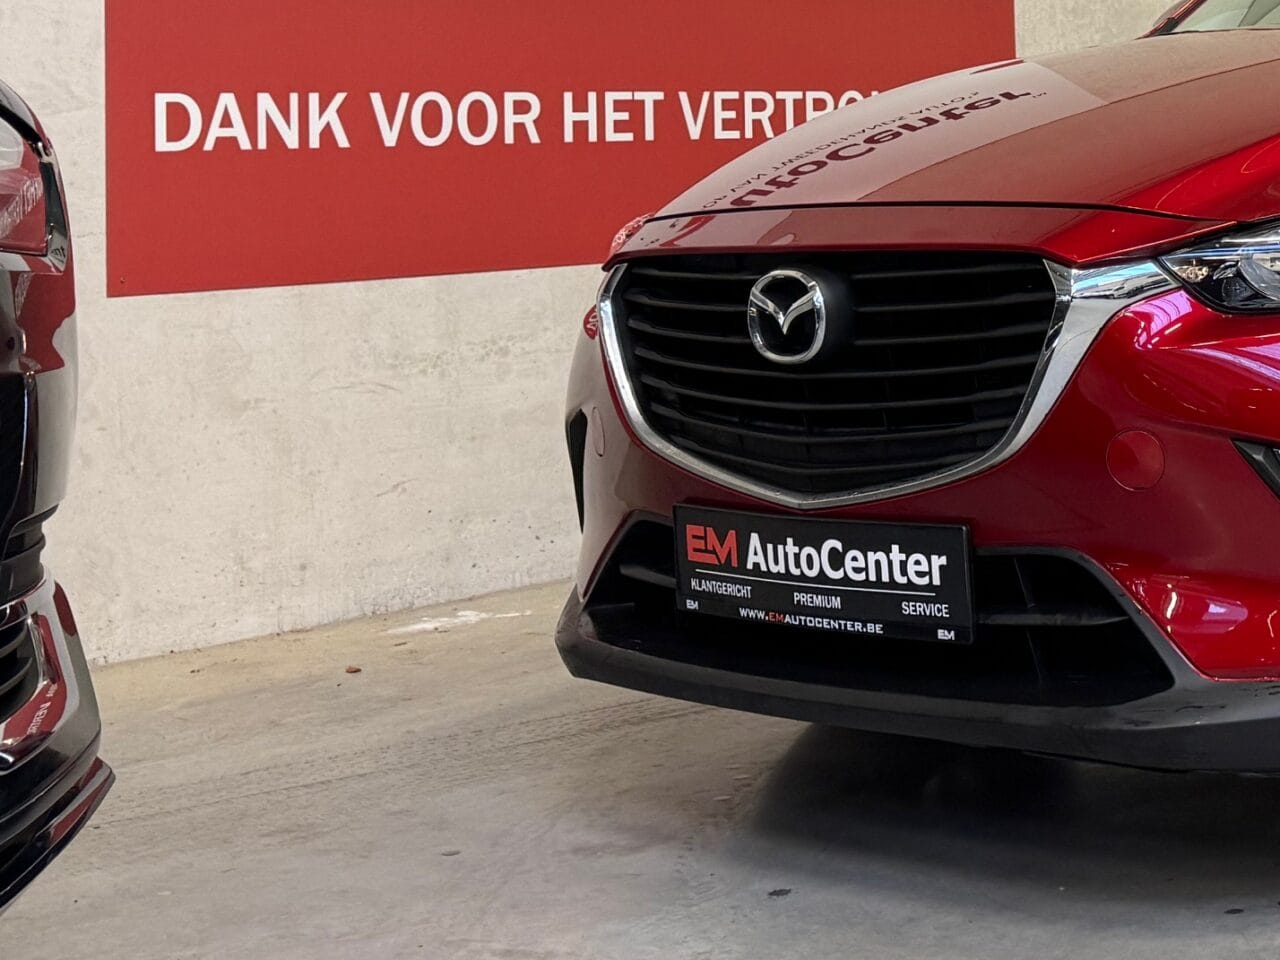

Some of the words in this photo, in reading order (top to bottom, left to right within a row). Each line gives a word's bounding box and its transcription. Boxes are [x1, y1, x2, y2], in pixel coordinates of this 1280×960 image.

[154, 91, 351, 153] DANK
[369, 90, 541, 148] VOOR
[563, 90, 665, 143] HET
[685, 523, 739, 568] EM
[746, 531, 948, 587] AutoCenter
[690, 577, 752, 599] KLANTGERICHT
[793, 591, 842, 610] PREMIUM
[901, 600, 950, 618] SERVICE
[739, 606, 884, 635] WWW.EMAUTOCENTER.BE
